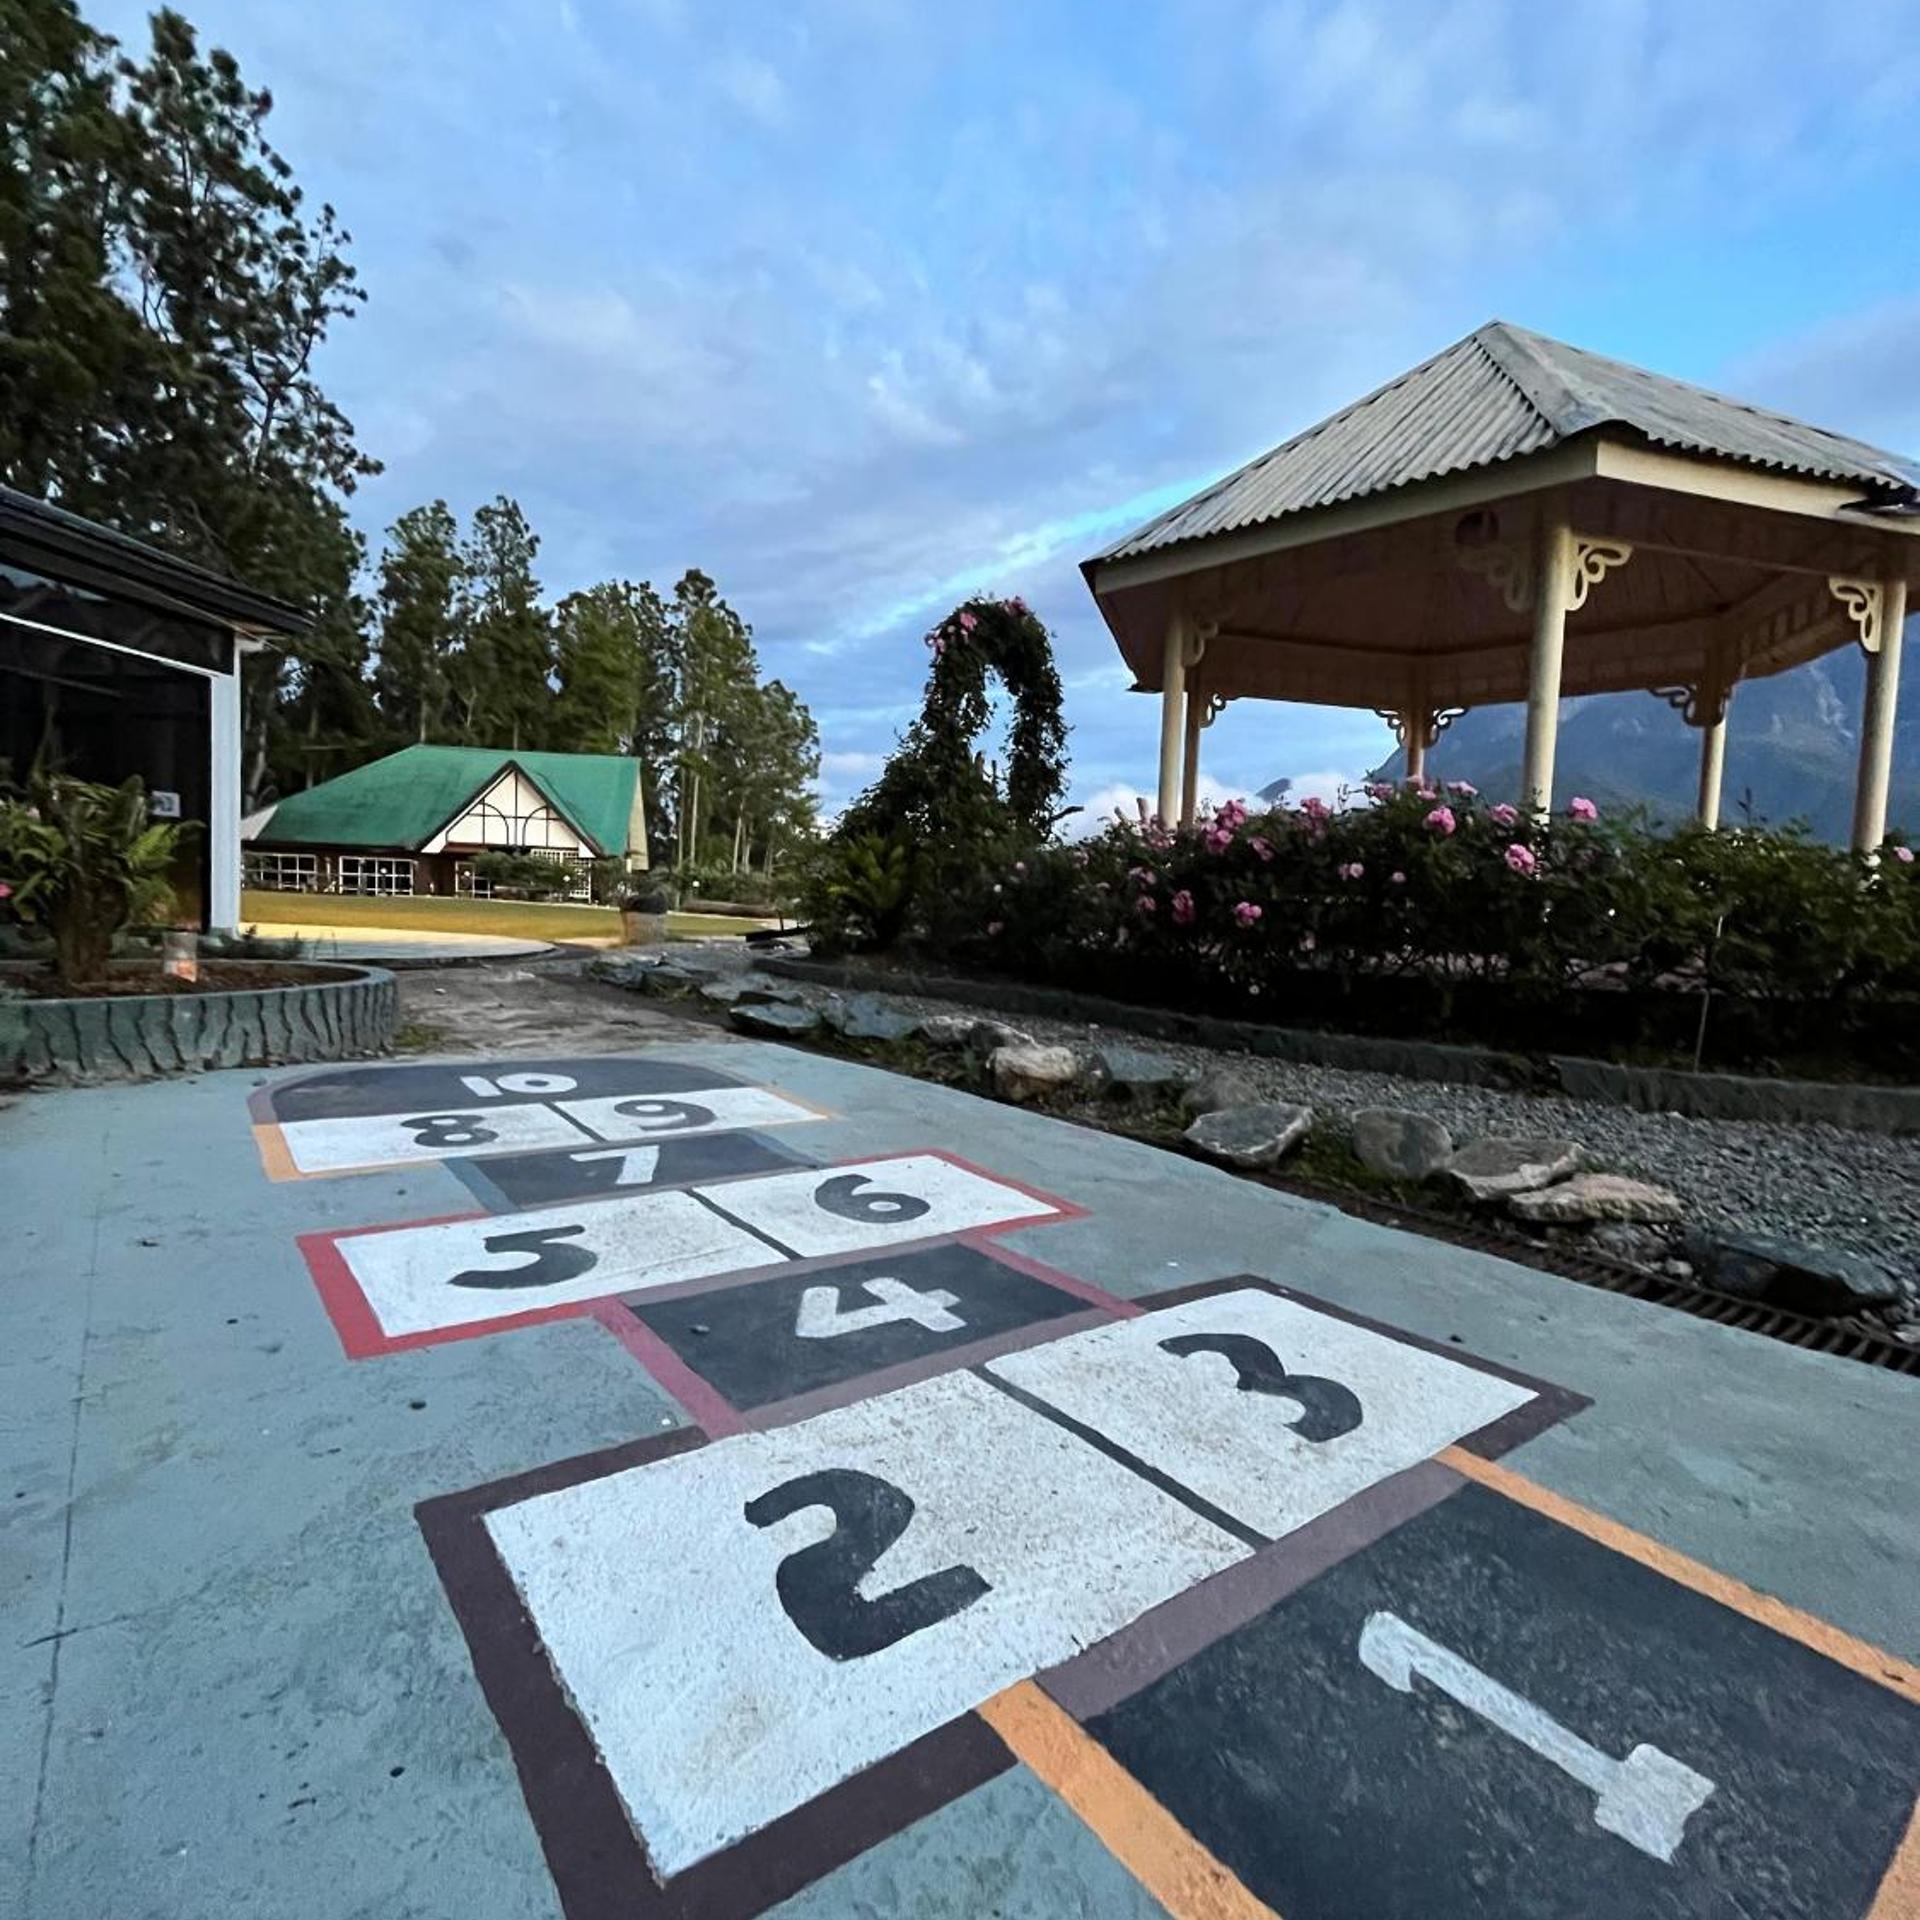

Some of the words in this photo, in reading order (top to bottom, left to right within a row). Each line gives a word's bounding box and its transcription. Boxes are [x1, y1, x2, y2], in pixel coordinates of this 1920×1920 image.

[460, 1073, 577, 1098] 10
[401, 1115, 499, 1148] 8
[614, 1100, 715, 1130] 9
[570, 1146, 659, 1185] 7
[815, 1174, 930, 1224] 6
[448, 1225, 598, 1290] 5
[795, 1277, 966, 1339] 4
[1158, 1333, 1362, 1442] 3
[743, 1467, 992, 1662] 2
[1357, 1610, 1714, 1864] 1
